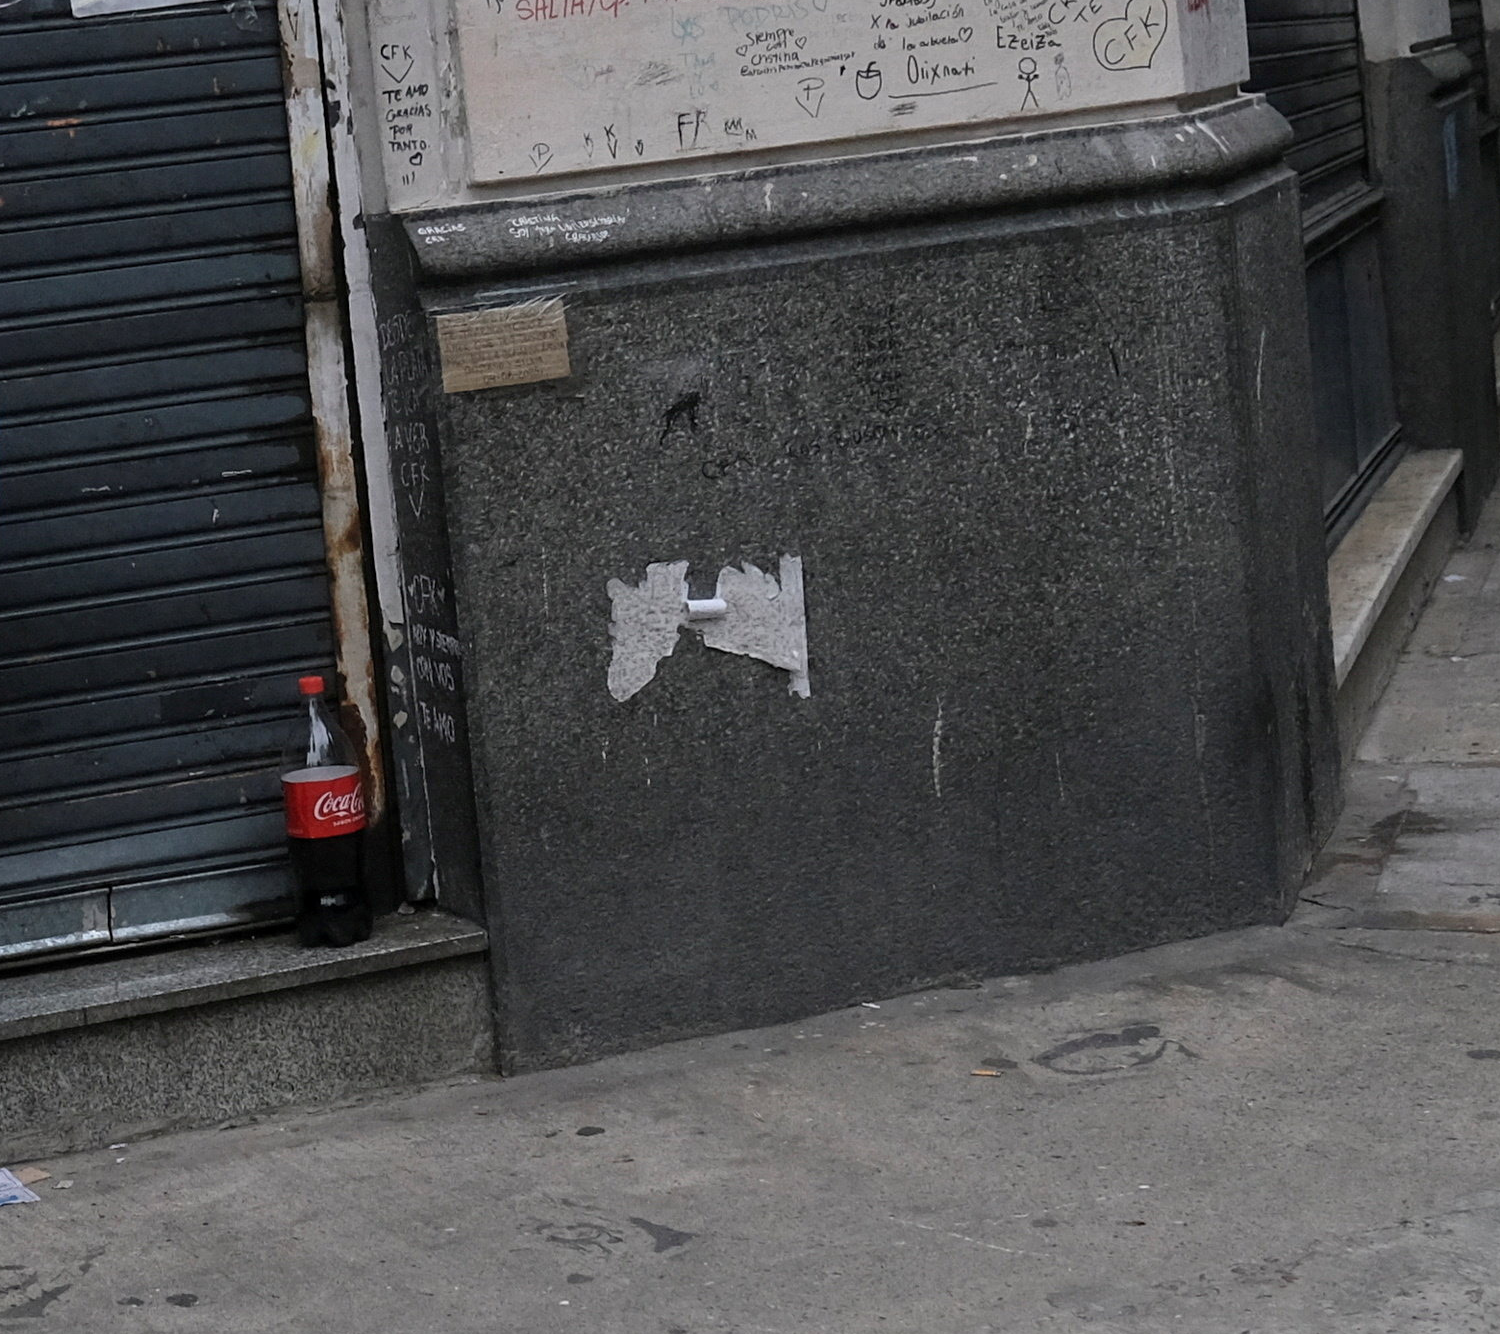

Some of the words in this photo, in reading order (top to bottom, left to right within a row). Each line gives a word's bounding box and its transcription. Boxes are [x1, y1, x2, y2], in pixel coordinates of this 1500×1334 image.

[1105, 5, 1160, 65] CFK
[380, 43, 413, 61] CFK
[382, 90, 403, 104] TE
[405, 84, 429, 98] AMO
[385, 103, 432, 123] GRACIAS
[389, 124, 413, 141] POR
[418, 223, 466, 235] GRACIAS
[401, 461, 430, 488] CFK
